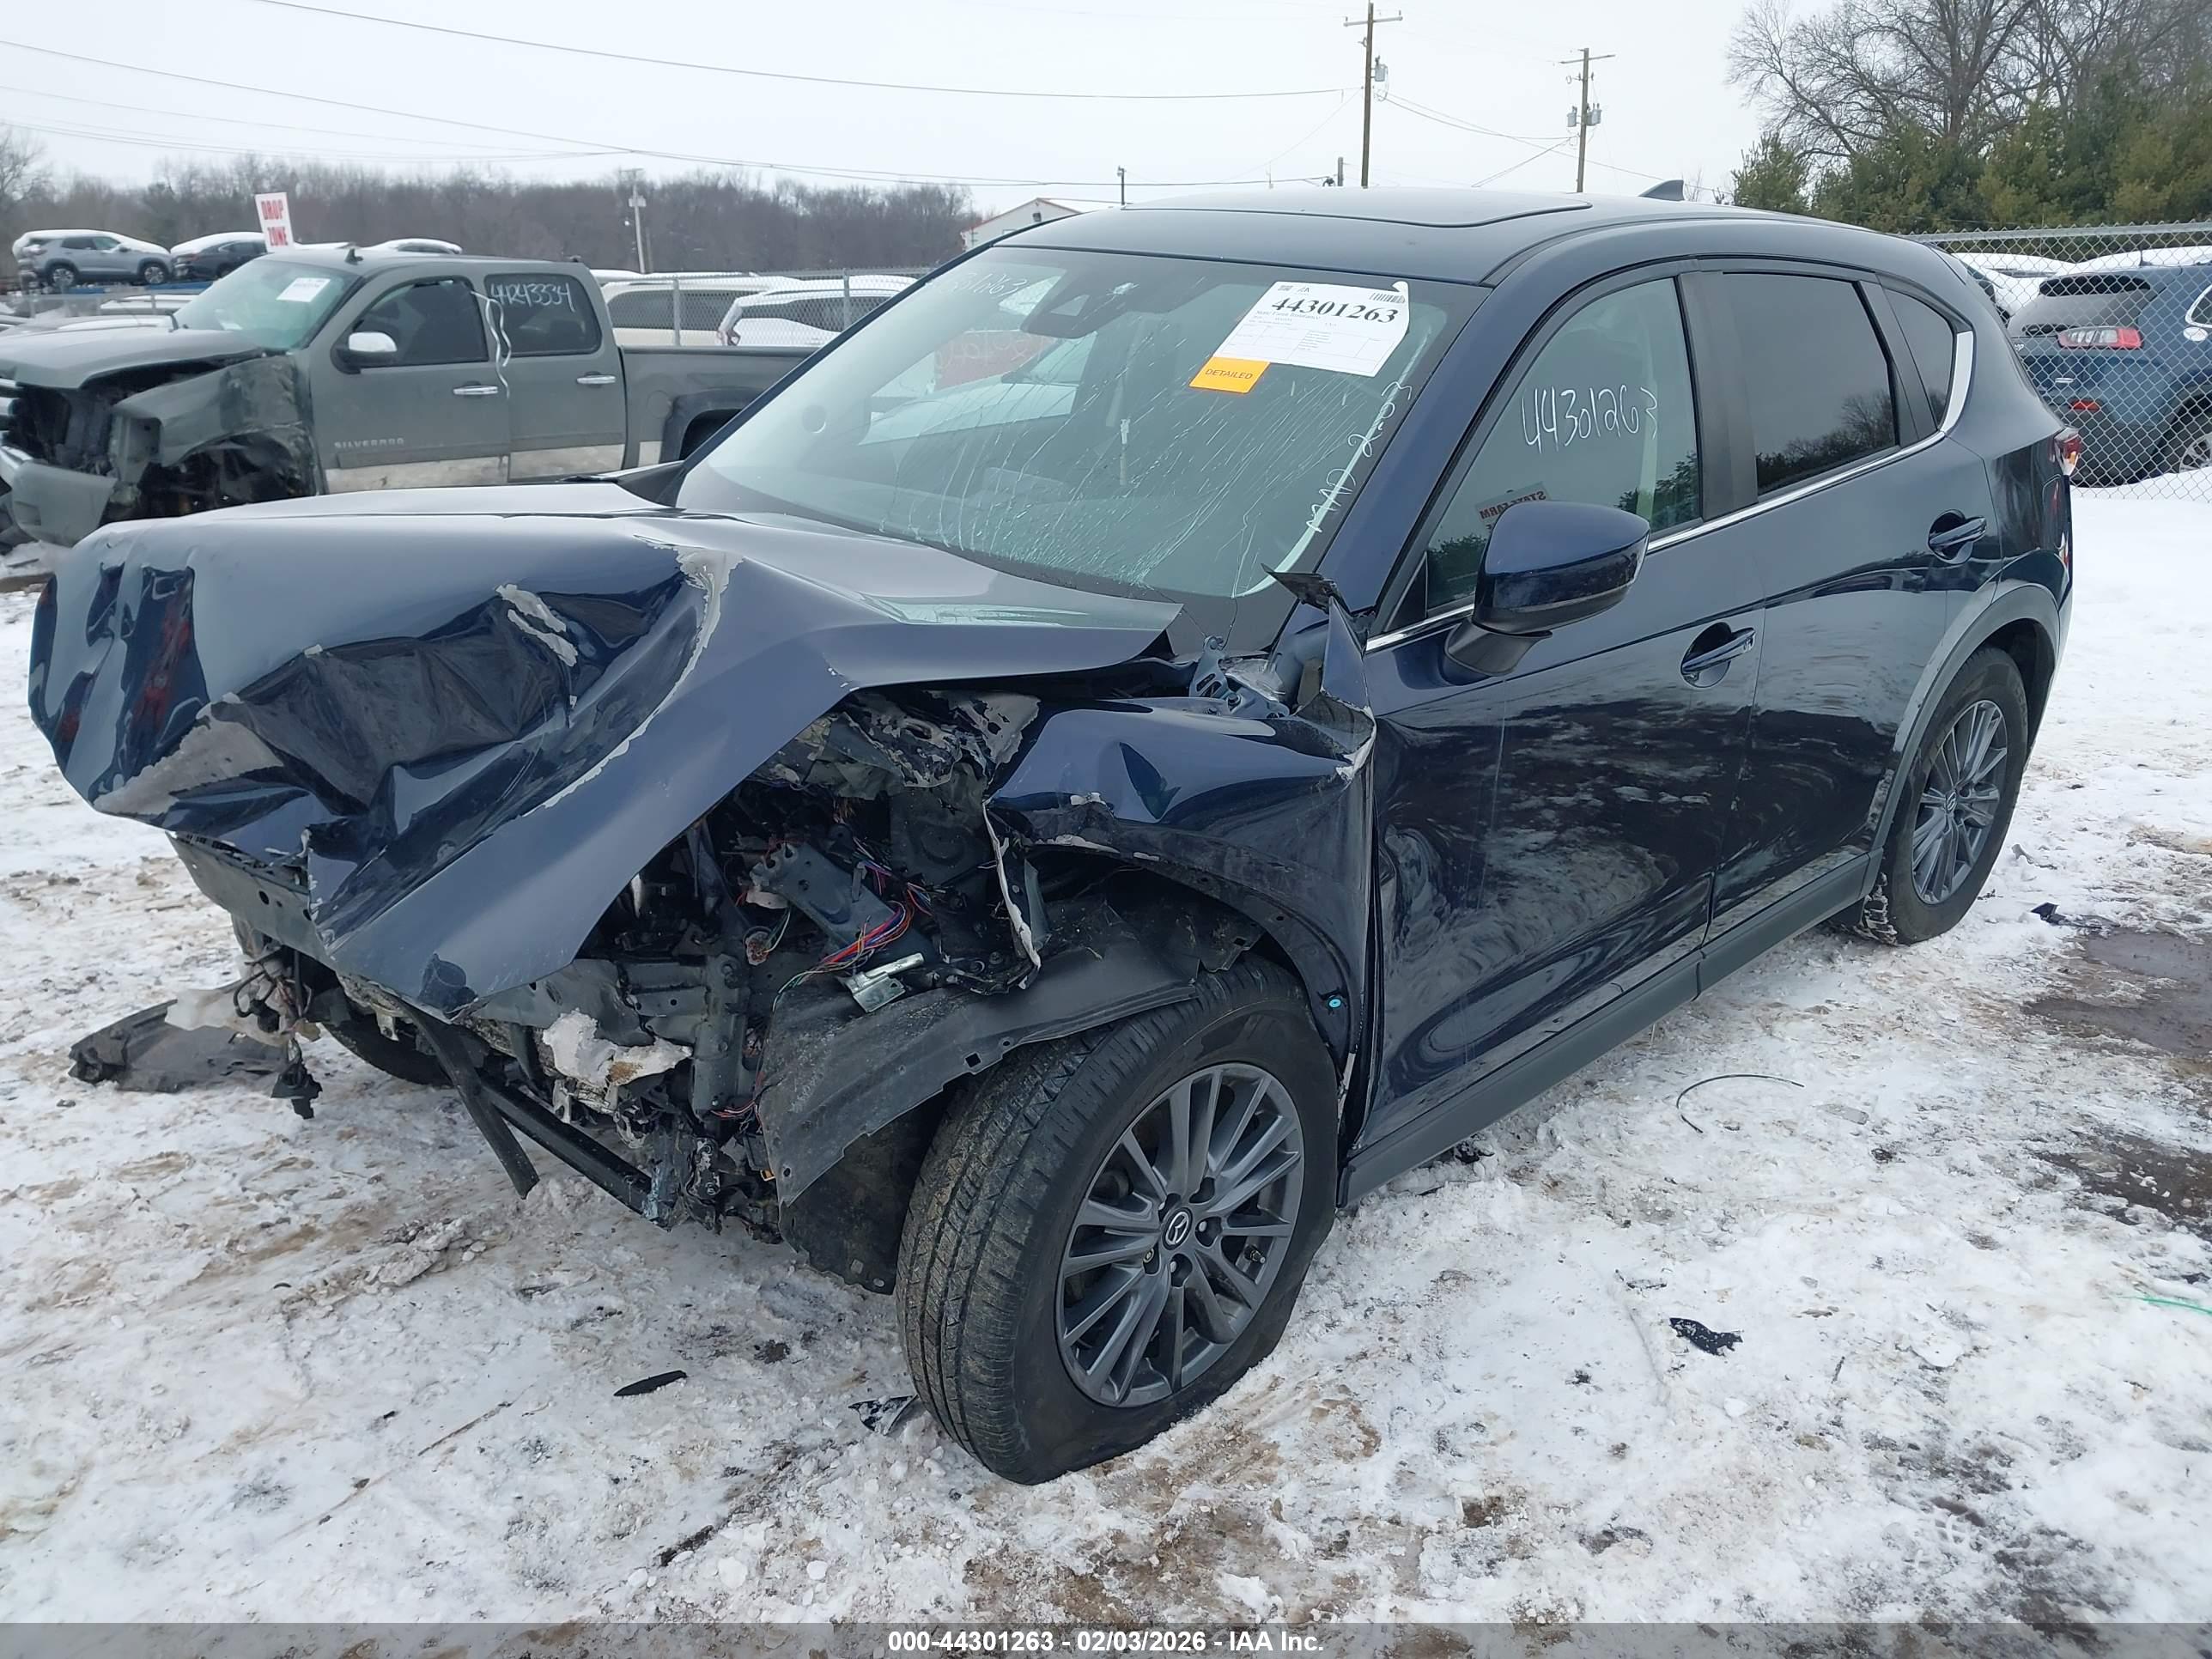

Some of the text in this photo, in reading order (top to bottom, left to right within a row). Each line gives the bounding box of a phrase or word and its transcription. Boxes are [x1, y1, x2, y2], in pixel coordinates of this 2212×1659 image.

[260, 199, 284, 221] DROP
[267, 226, 289, 247] ZONE
[1272, 297, 1399, 323] 44301263
[1205, 368, 1254, 380] DETAILED
[1522, 386, 1658, 453] 44301263
